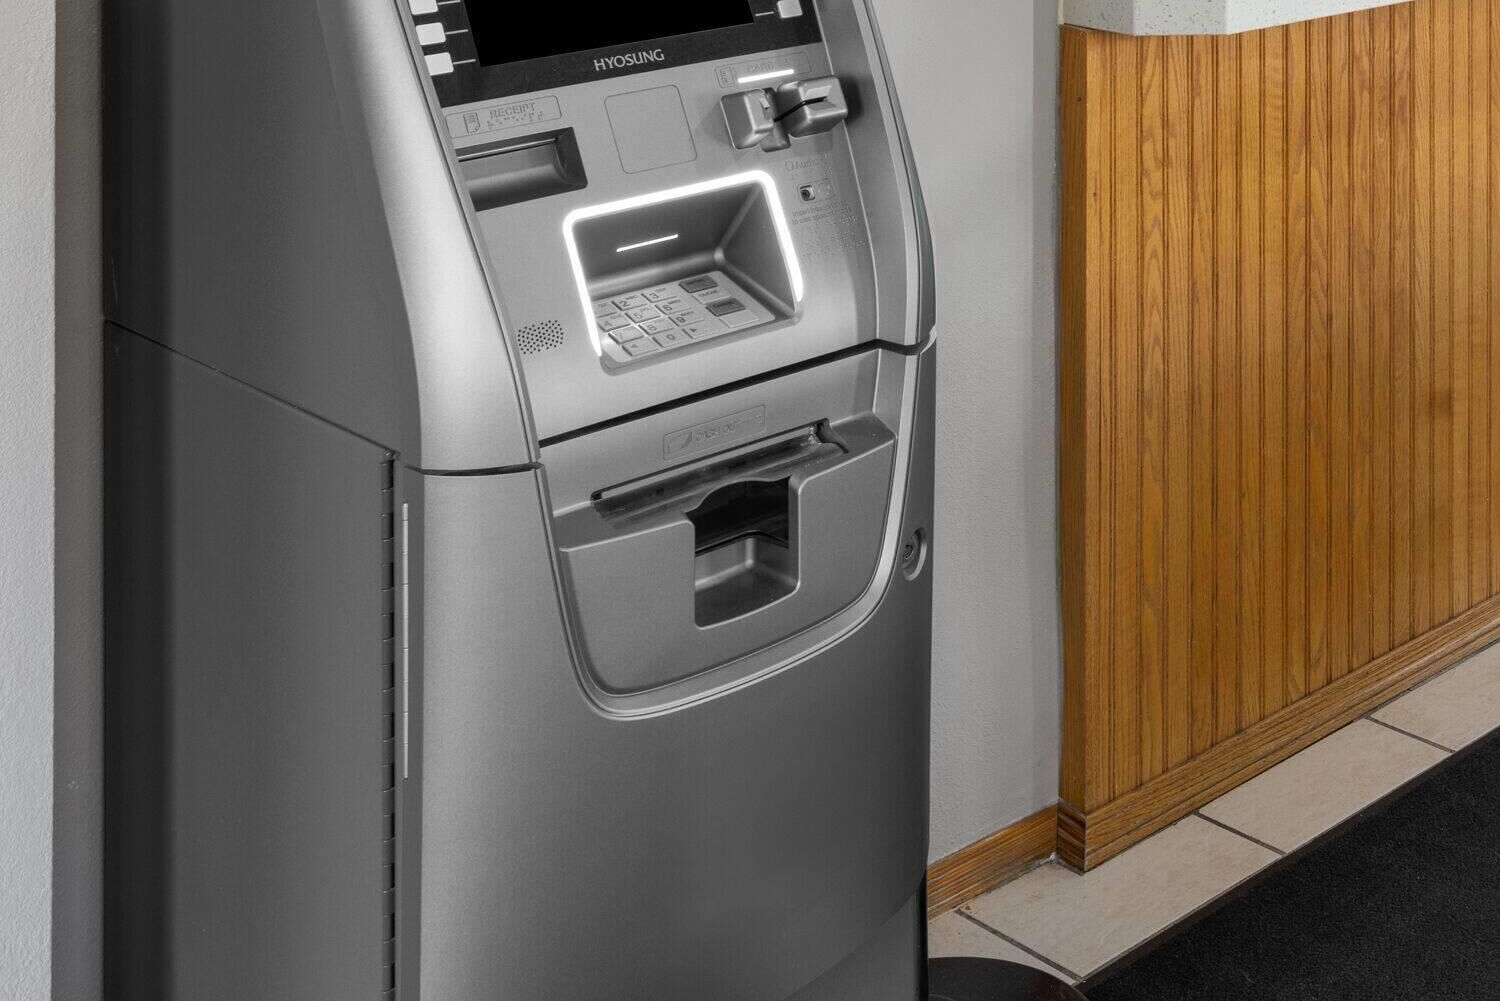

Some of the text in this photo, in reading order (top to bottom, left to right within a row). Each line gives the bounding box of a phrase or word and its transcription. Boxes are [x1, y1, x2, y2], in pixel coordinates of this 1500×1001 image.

[593, 48, 665, 73] HYOSUNG
[490, 102, 536, 119] RECEIPT
[649, 292, 660, 300] 3
[619, 300, 630, 308] 2
